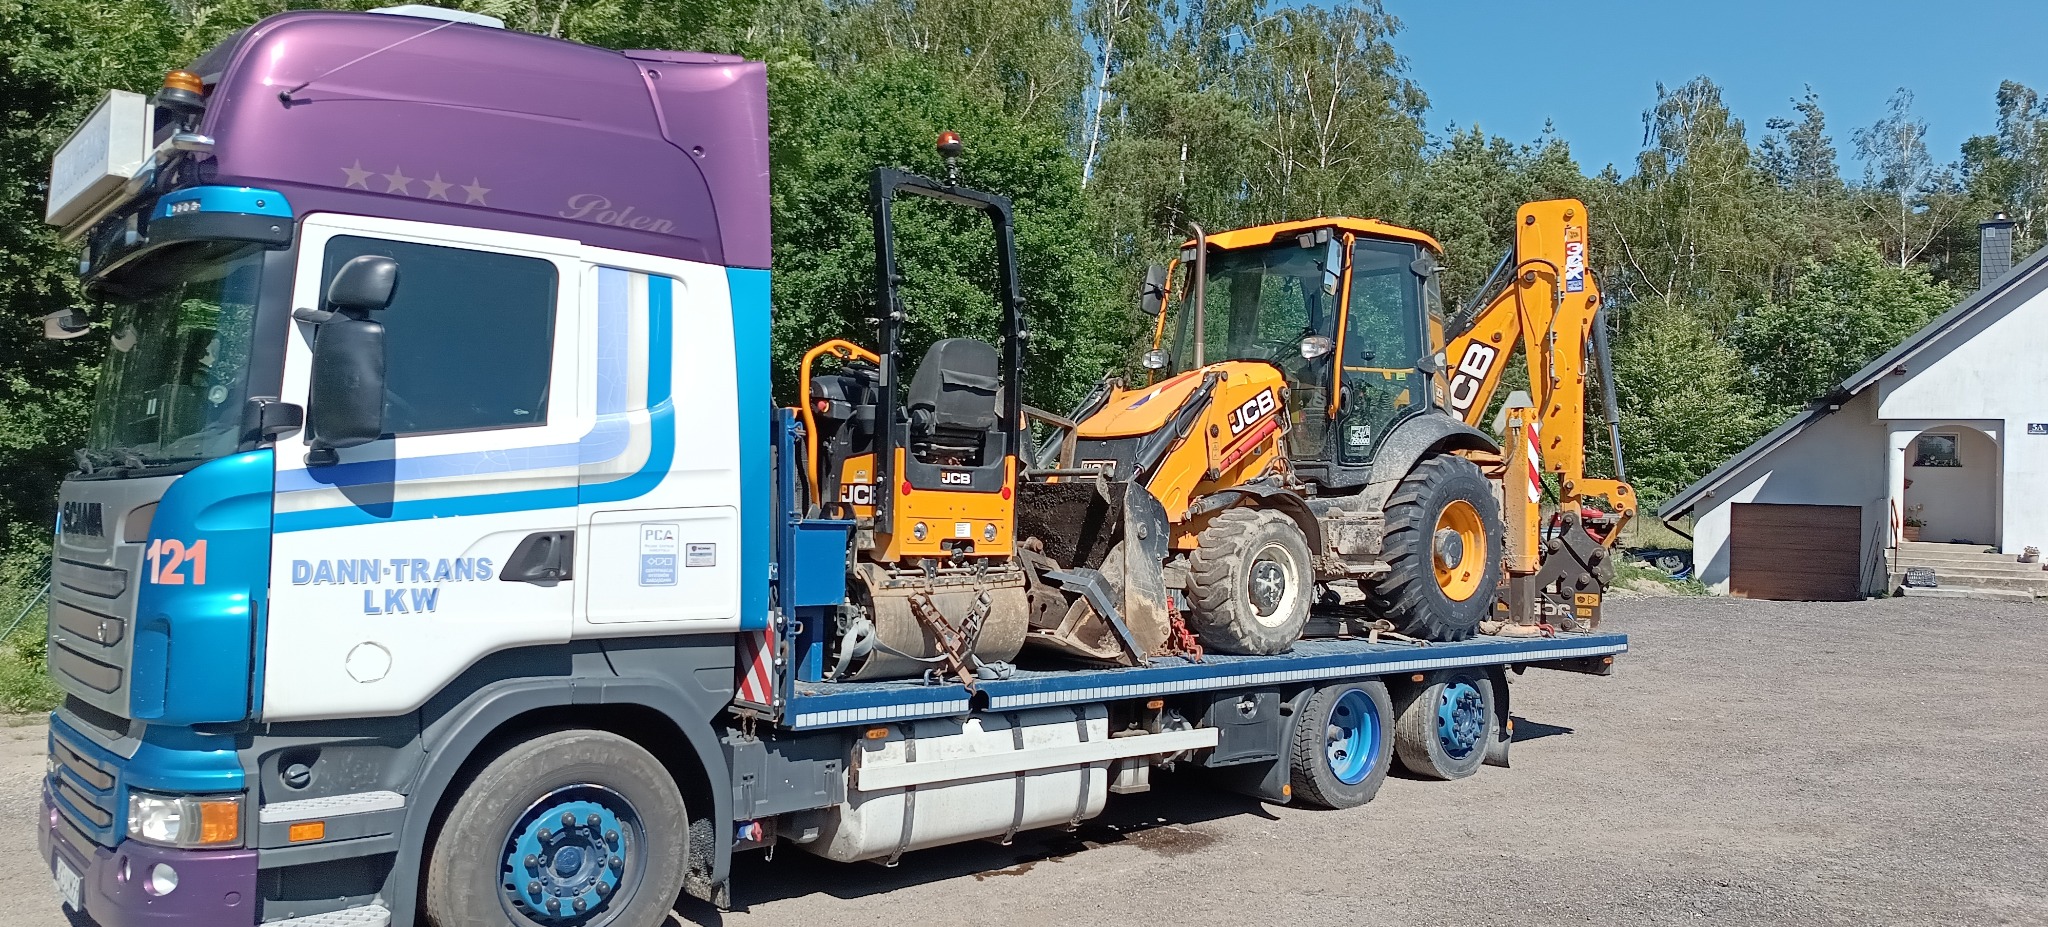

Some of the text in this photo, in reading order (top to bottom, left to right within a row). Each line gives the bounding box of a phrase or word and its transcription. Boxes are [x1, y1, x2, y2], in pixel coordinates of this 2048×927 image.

[558, 193, 677, 234] Polen
[1450, 343, 1495, 421] CB
[1231, 389, 1275, 434] JCB
[941, 472, 971, 485] JCB
[645, 529, 674, 541] PCA
[147, 538, 208, 585] 121
[363, 587, 440, 616] LKW
